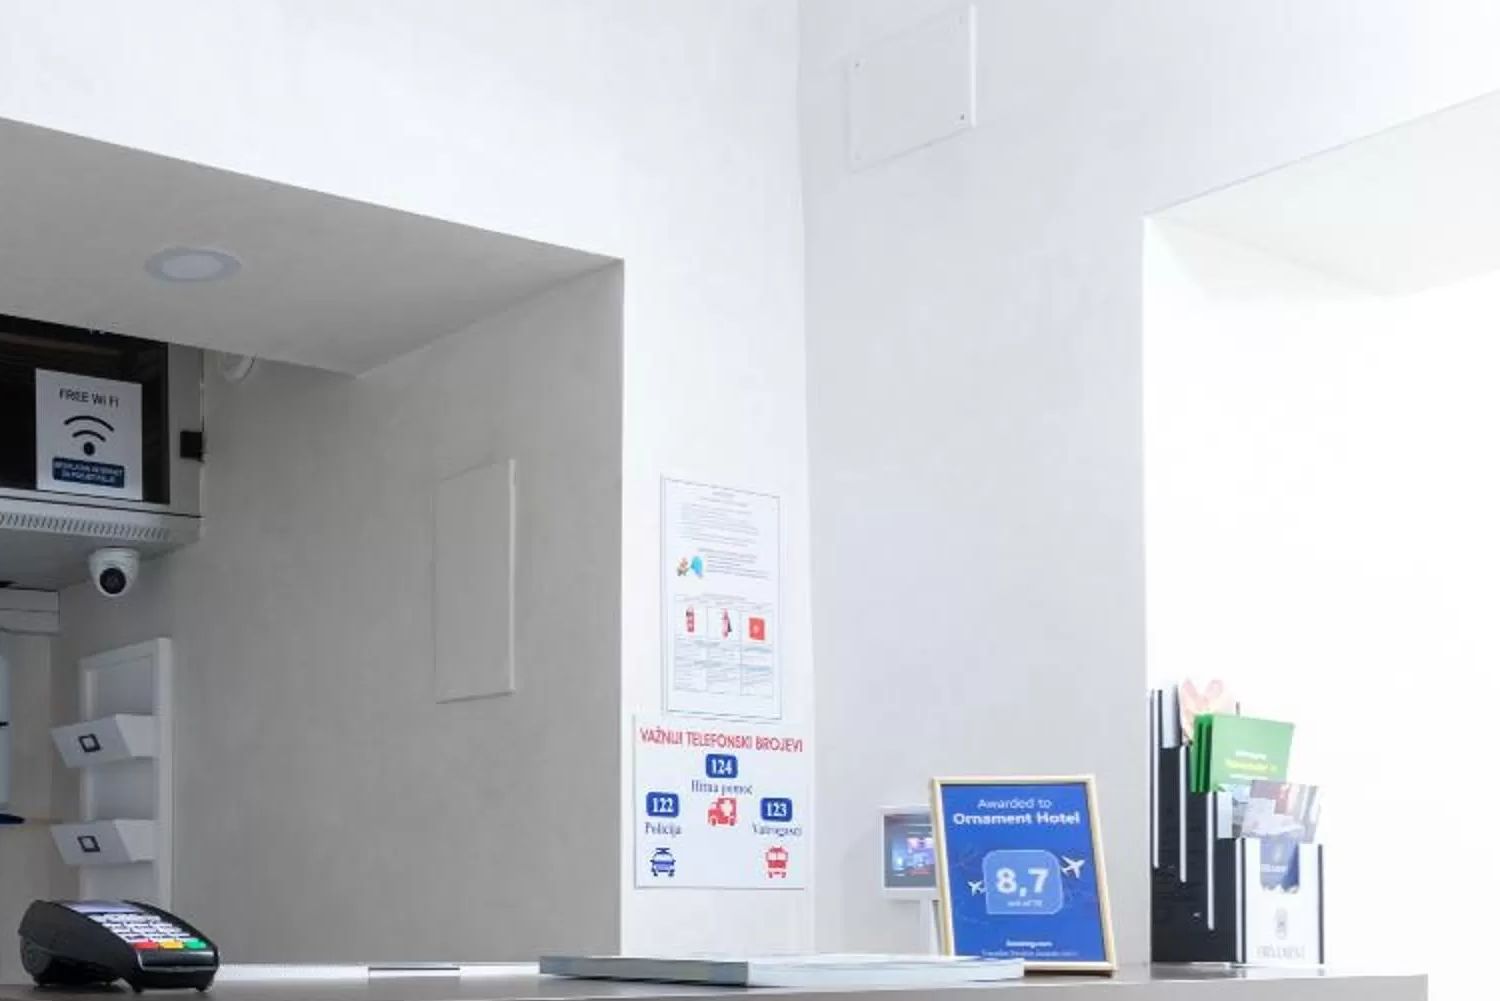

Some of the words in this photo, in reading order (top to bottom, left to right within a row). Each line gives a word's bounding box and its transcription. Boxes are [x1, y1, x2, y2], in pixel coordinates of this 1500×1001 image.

[59, 388, 89, 403] FREE
[685, 731, 753, 749] TELEFONSKI
[755, 735, 803, 753] BROJEVI
[710, 758, 733, 775] 124
[691, 779, 717, 793] Hitna
[652, 797, 674, 813] 122
[766, 801, 788, 817] 123
[977, 799, 1035, 809] Awarded
[1038, 799, 1053, 809] to
[953, 813, 1032, 825] Ornament
[1036, 811, 1081, 825] Hotel
[644, 822, 682, 838] Policija
[995, 867, 1049, 897] 8,7
